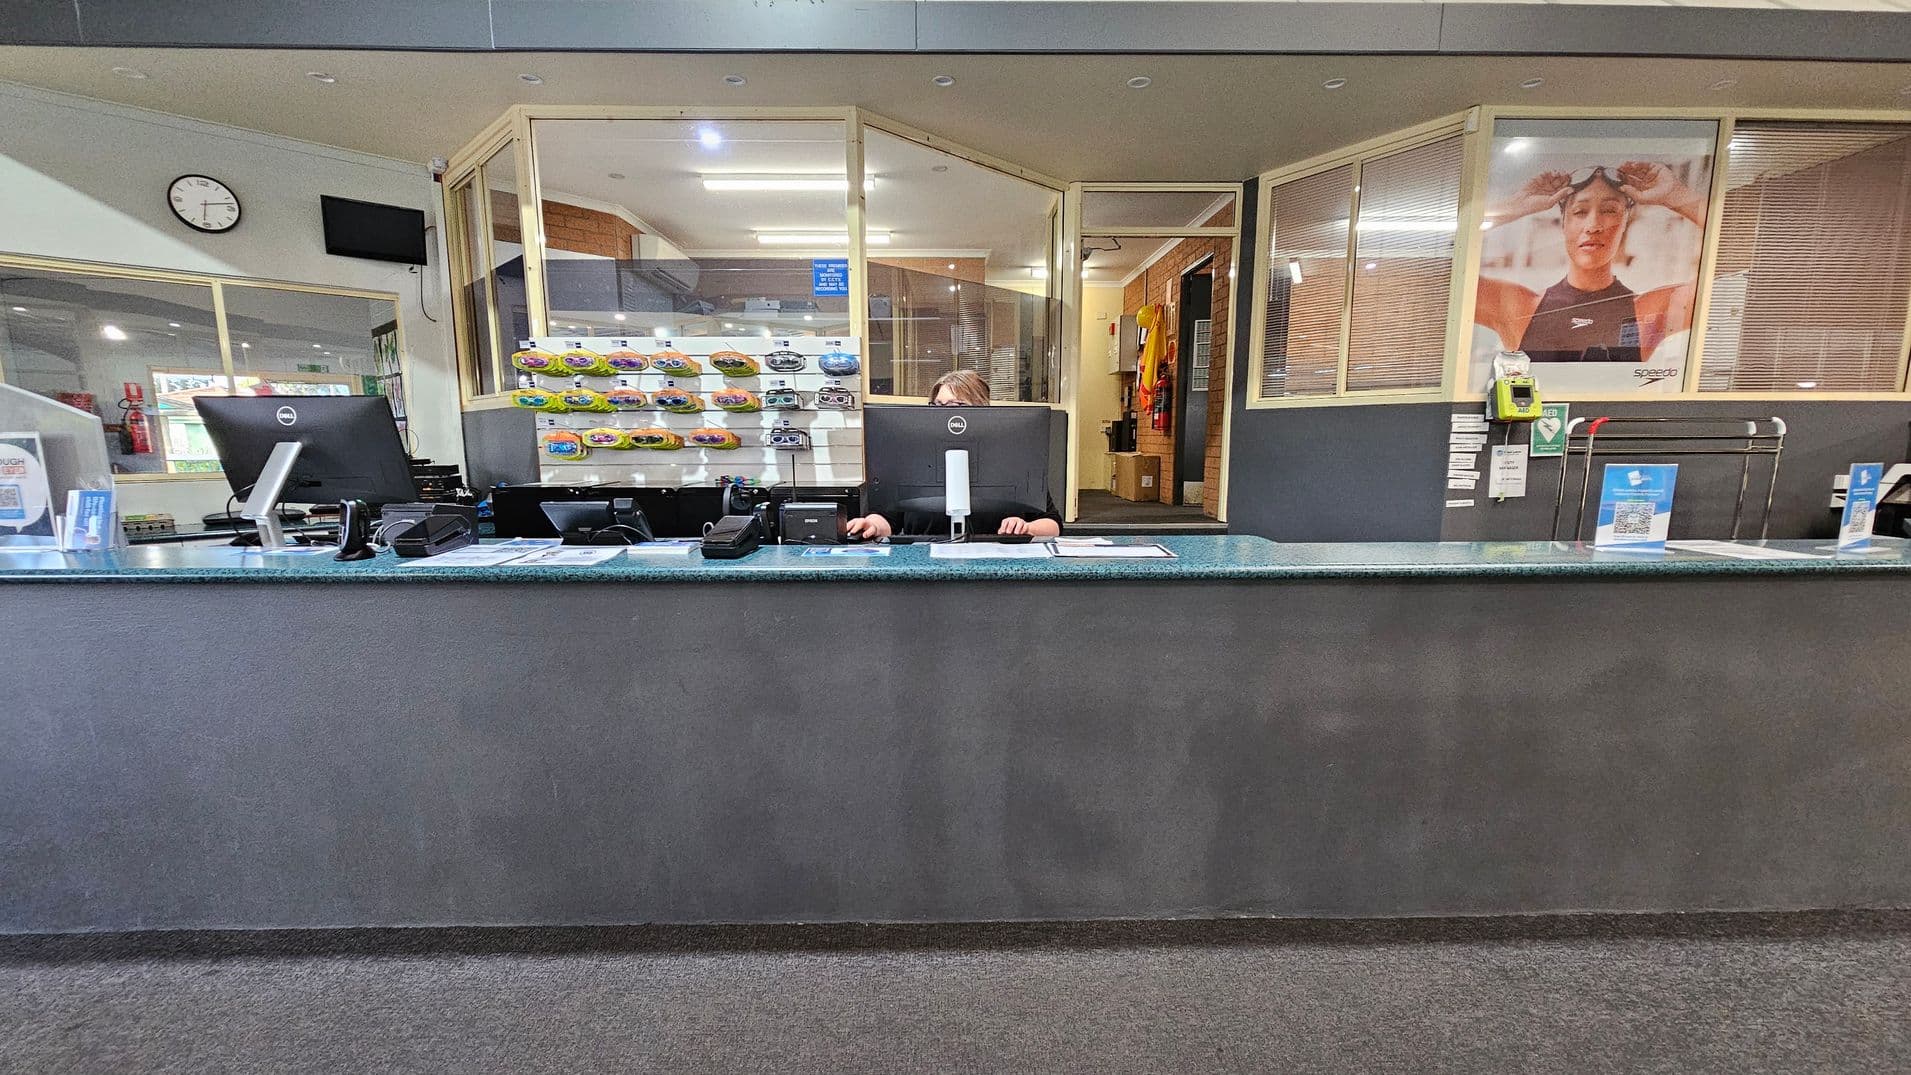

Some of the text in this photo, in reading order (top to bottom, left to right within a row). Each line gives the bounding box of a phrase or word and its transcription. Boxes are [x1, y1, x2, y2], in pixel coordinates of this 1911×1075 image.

[196, 179, 210, 188] 12
[1633, 368, 1678, 378] speedo
[1543, 409, 1558, 417] AED
